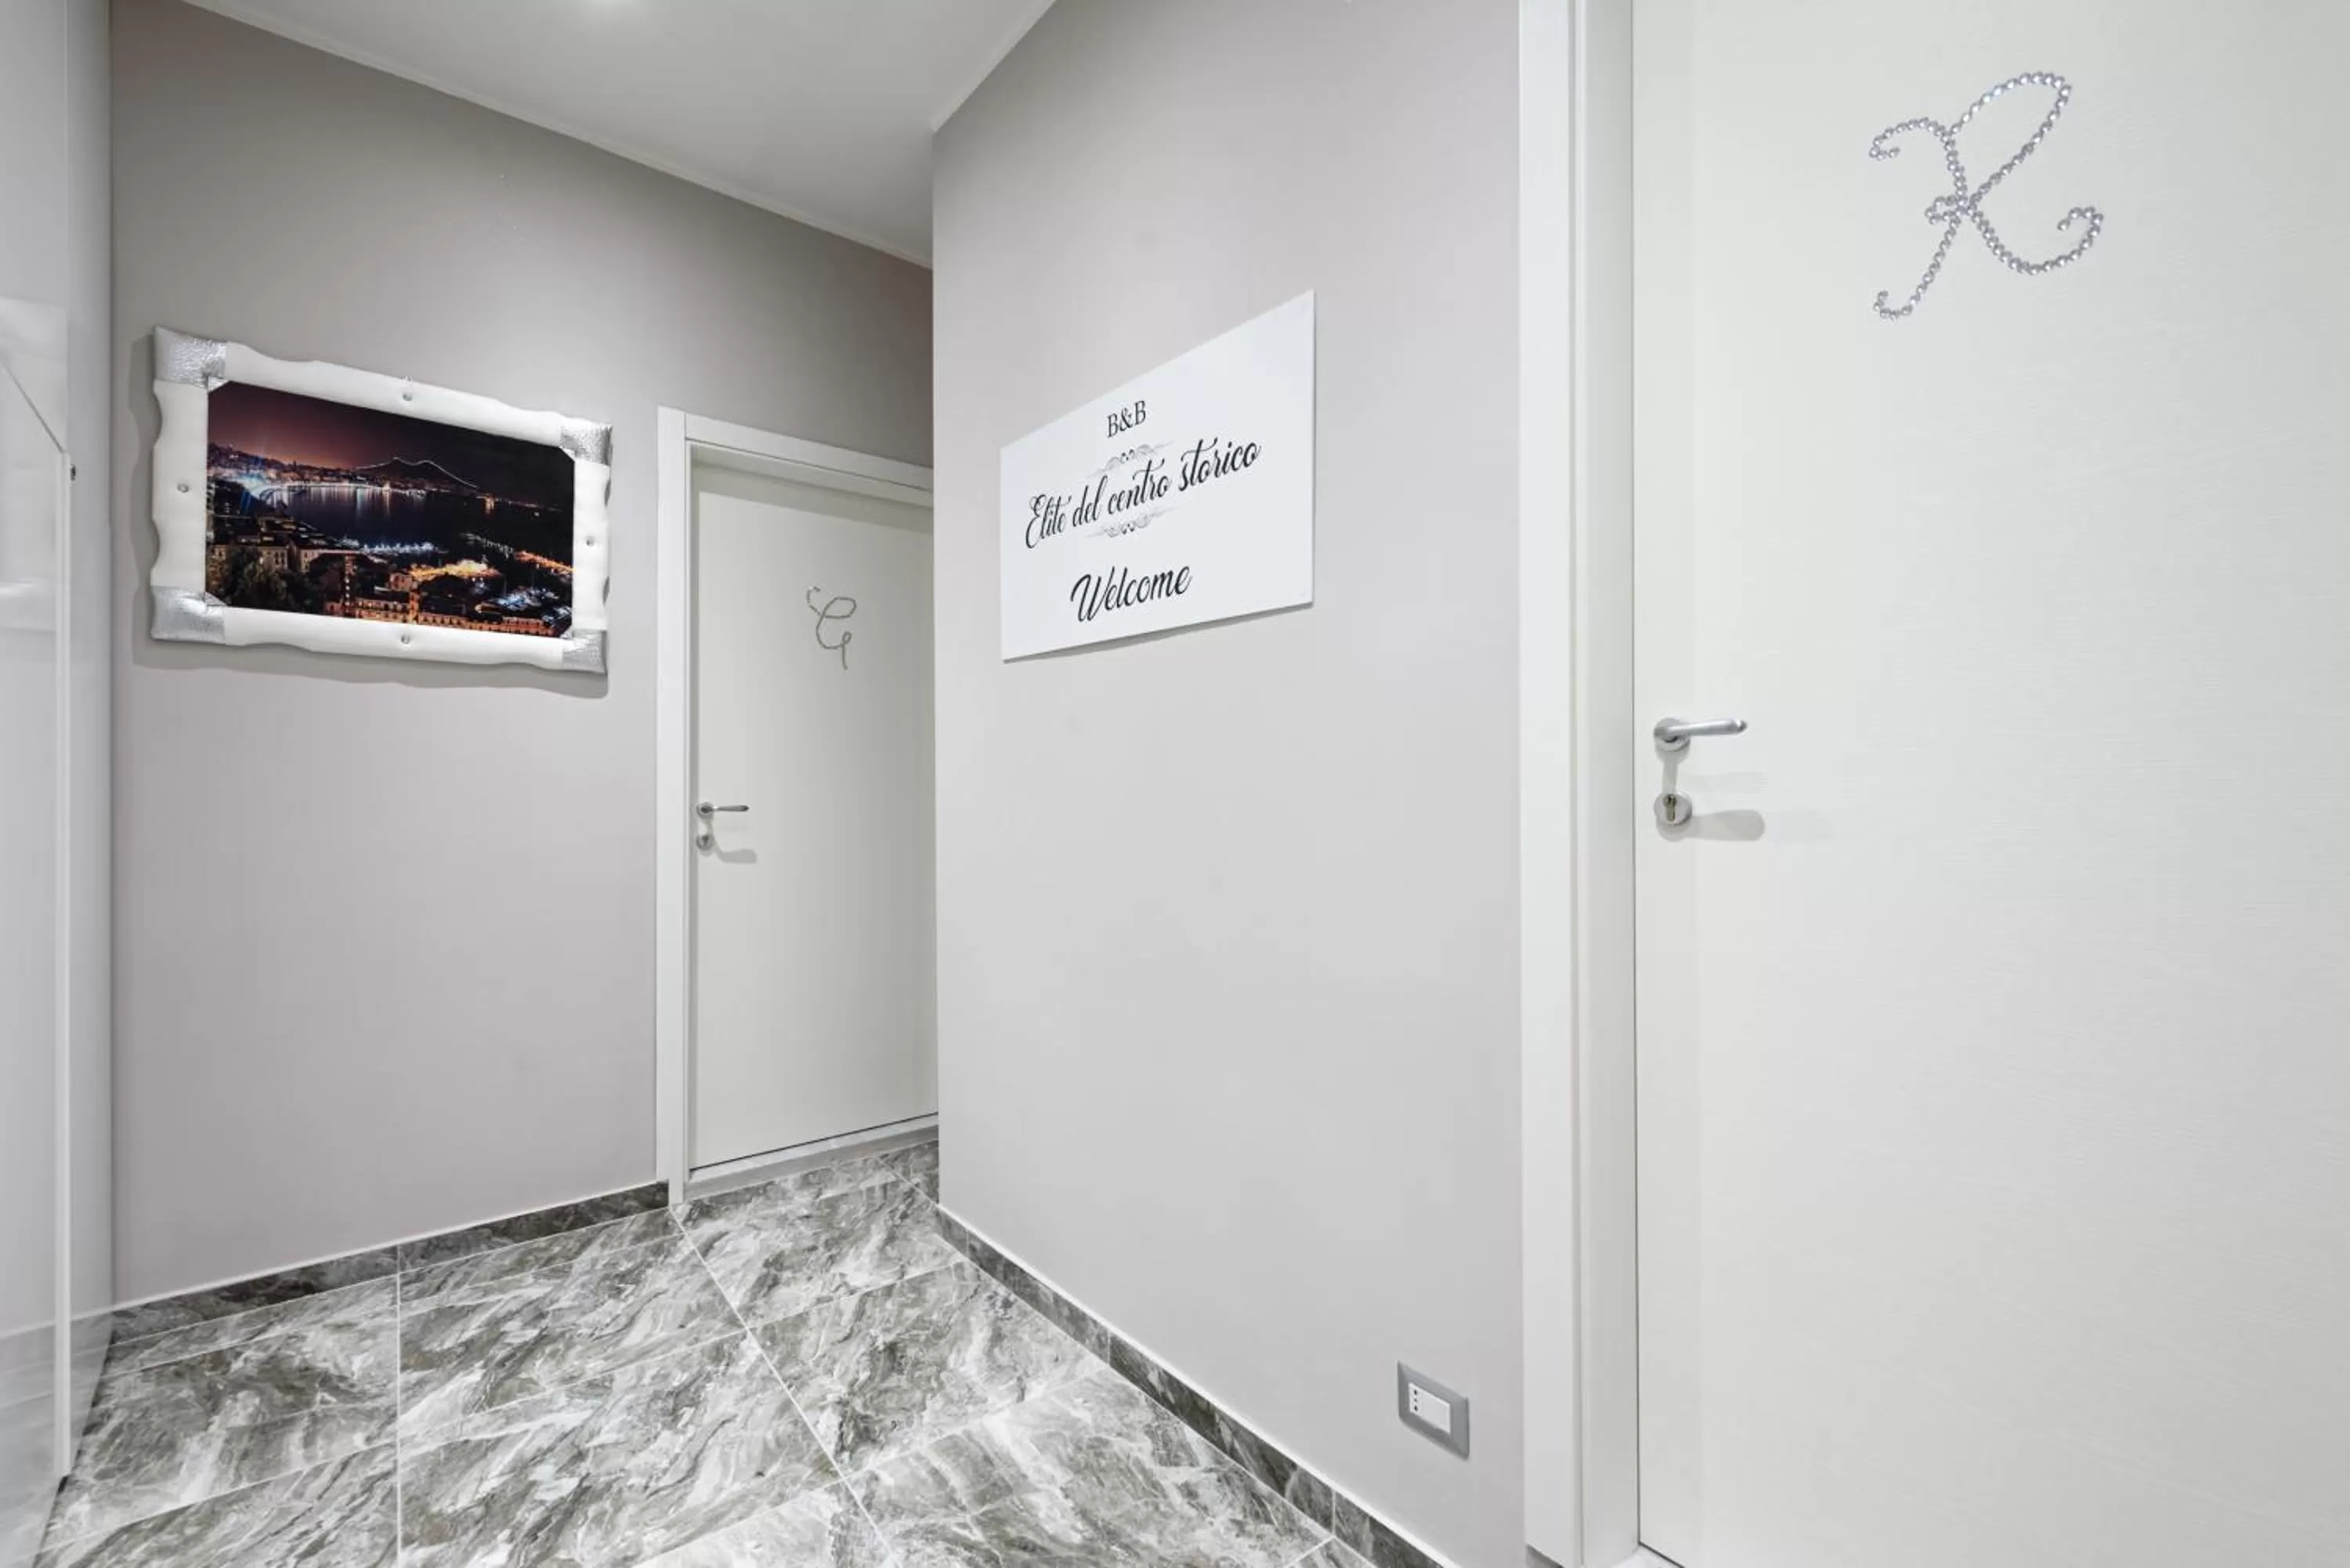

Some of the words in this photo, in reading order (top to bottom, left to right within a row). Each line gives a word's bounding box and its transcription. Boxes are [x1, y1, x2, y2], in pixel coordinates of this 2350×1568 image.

[1107, 400, 1147, 438] B&B
[1072, 475, 1108, 527] del
[1107, 458, 1171, 515] centro
[1178, 436, 1261, 492] storico
[1070, 565, 1192, 623] Welcome
